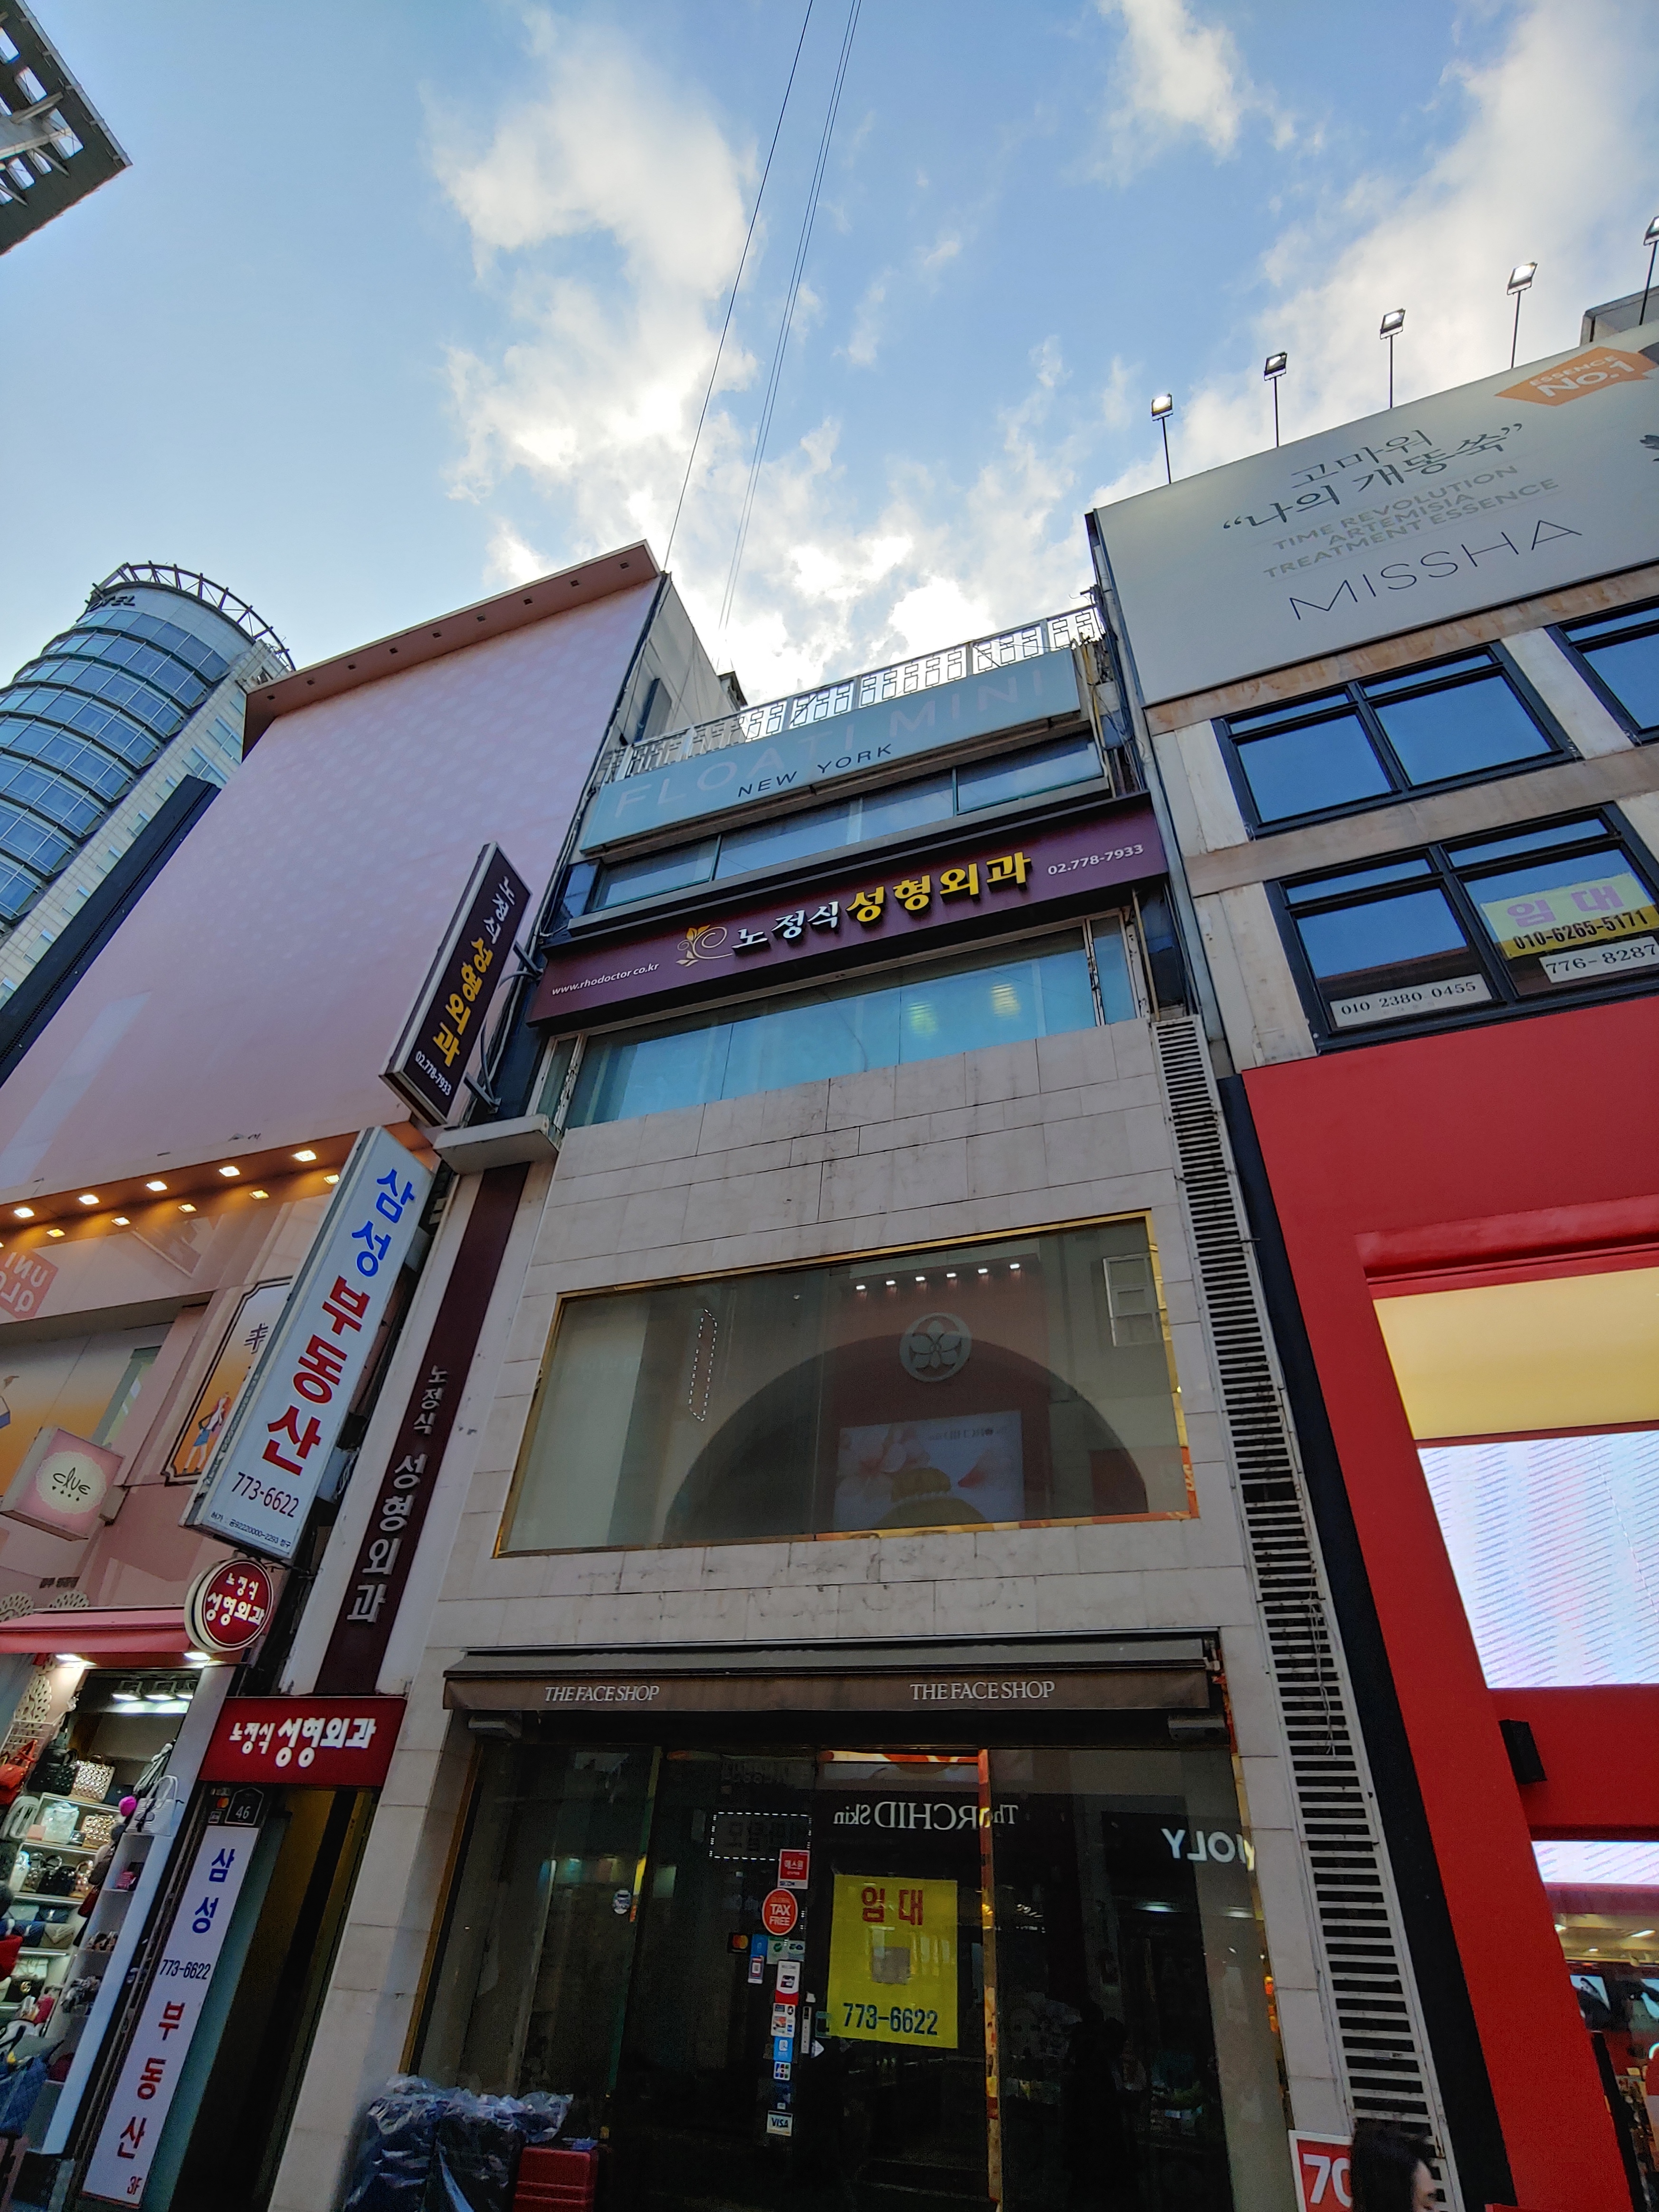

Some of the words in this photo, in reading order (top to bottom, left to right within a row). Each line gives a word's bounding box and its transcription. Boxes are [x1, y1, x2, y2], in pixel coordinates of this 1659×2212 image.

[1530, 355, 1617, 386] ESSENCE
[1537, 360, 1635, 397] NO.1
[1291, 429, 1433, 488] 고마워
[1264, 521, 1421, 578] TREATMENT
[1431, 479, 1559, 524] ESSENCE
[1273, 524, 1334, 550] TIME
[1341, 465, 1518, 526] REVOLUTION
[1329, 492, 1476, 546] ARTEMISIA
[1289, 520, 1583, 620] MISSHA
[889, 667, 1042, 738] MINI
[737, 771, 798, 798] NEW
[817, 743, 893, 772] YORK
[1047, 844, 1145, 876] 02.778-7933
[483, 876, 515, 944] 노정식
[732, 901, 839, 949] 노정식
[846, 851, 1032, 923] 성형외과
[1513, 910, 1648, 950] 010-6265-5171
[1546, 944, 1656, 974] 776-8287
[433, 937, 494, 1068] 성형외과
[415, 1050, 452, 1096] 02.778-7933
[352, 1168, 416, 1278] 삼성
[261, 1275, 371, 1477] 부동산
[413, 1365, 448, 1436] 노정식
[231, 1471, 299, 1518] 773-6622
[346, 1452, 428, 1623] 성형외과
[206, 1592, 265, 1626] 성형외과
[226, 1573, 259, 1601] 노정식
[229, 1722, 276, 1754] 노정식
[275, 1717, 377, 1768] 성형외과
[235, 1805, 251, 1820] 46
[192, 1848, 234, 1933] 삼성
[770, 1903, 791, 1916] TAX
[769, 1916, 791, 1926] FREE
[160, 1959, 210, 1981] 773-6622
[843, 2002, 938, 2035] 773-6622
[117, 2001, 185, 2159] 부동산
[772, 2117, 788, 2127] VISA
[127, 2176, 142, 2195] 3F
